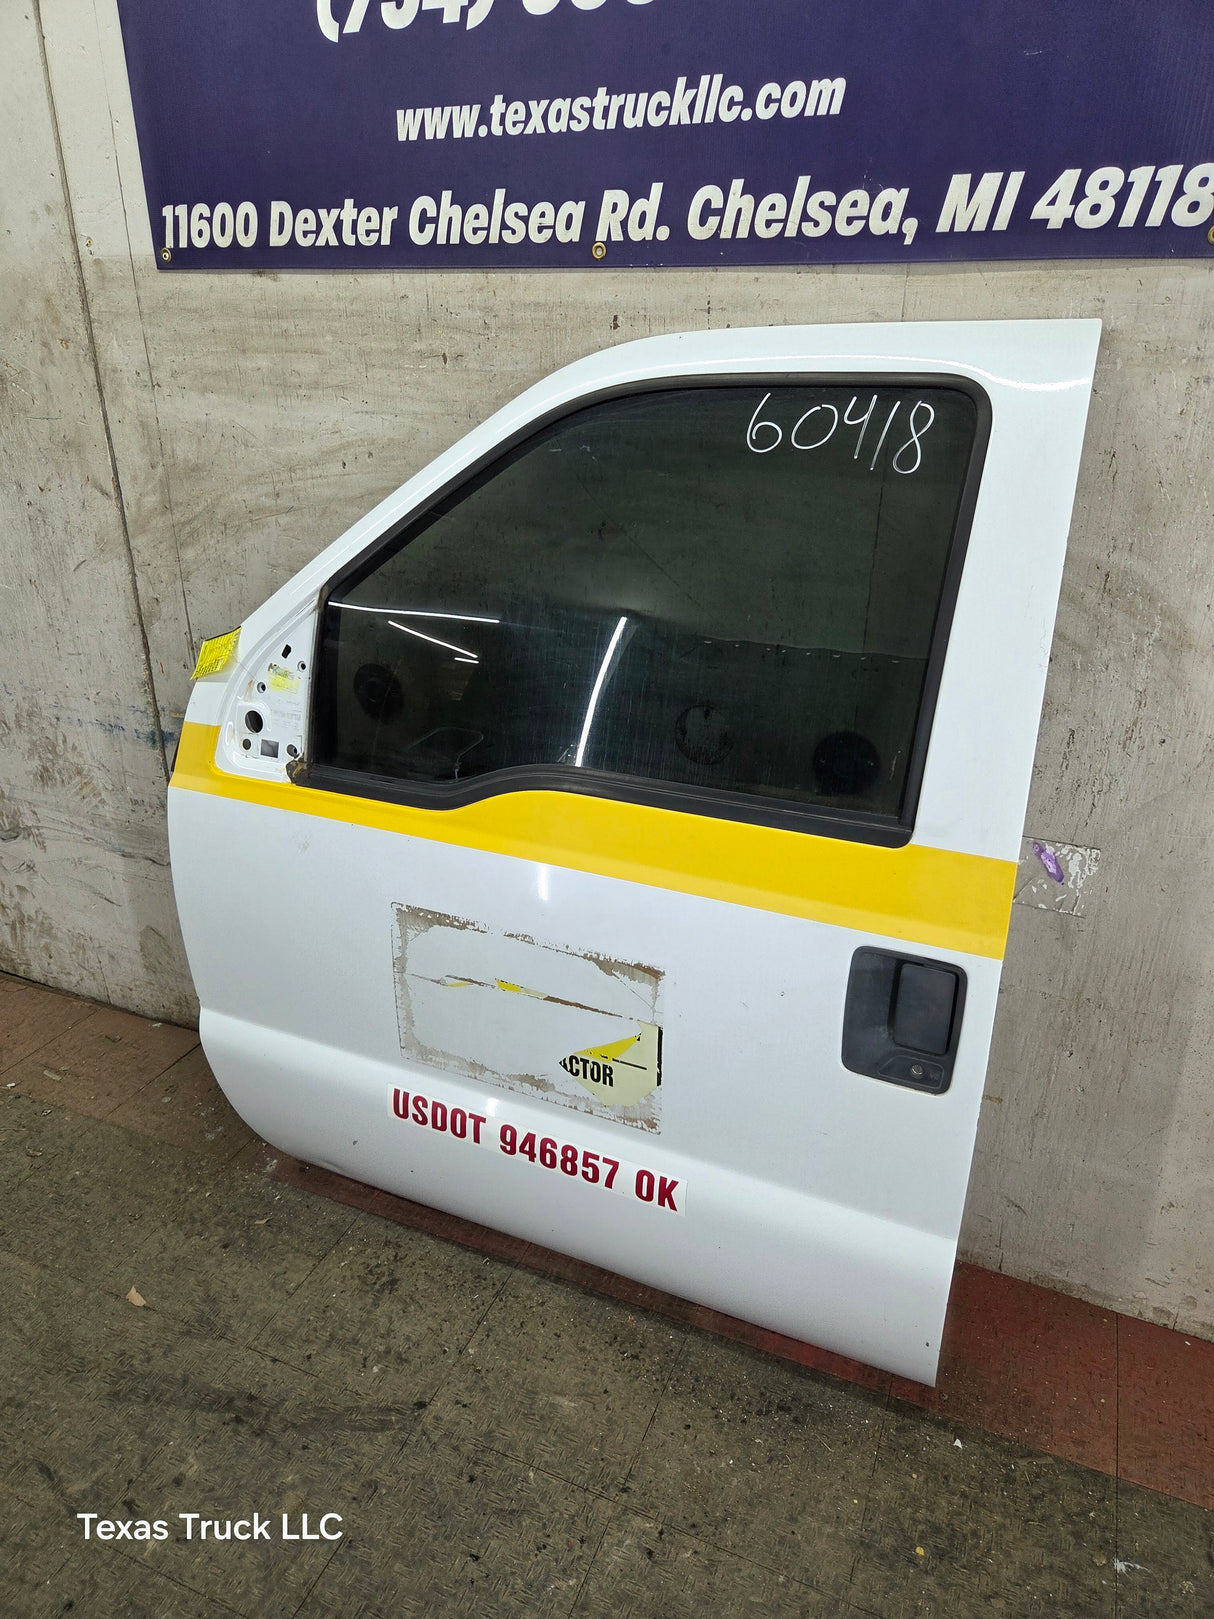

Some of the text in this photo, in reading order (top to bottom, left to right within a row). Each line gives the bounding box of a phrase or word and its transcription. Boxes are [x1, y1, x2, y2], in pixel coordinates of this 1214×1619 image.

[397, 74, 847, 142] www.texastruckllc.com
[162, 163, 1214, 249] 11600 Dexter Chelsea Rd. Chelsea, MI 48118
[746, 392, 935, 474] 60418
[393, 1087, 680, 1212] USDOT 946857 OK
